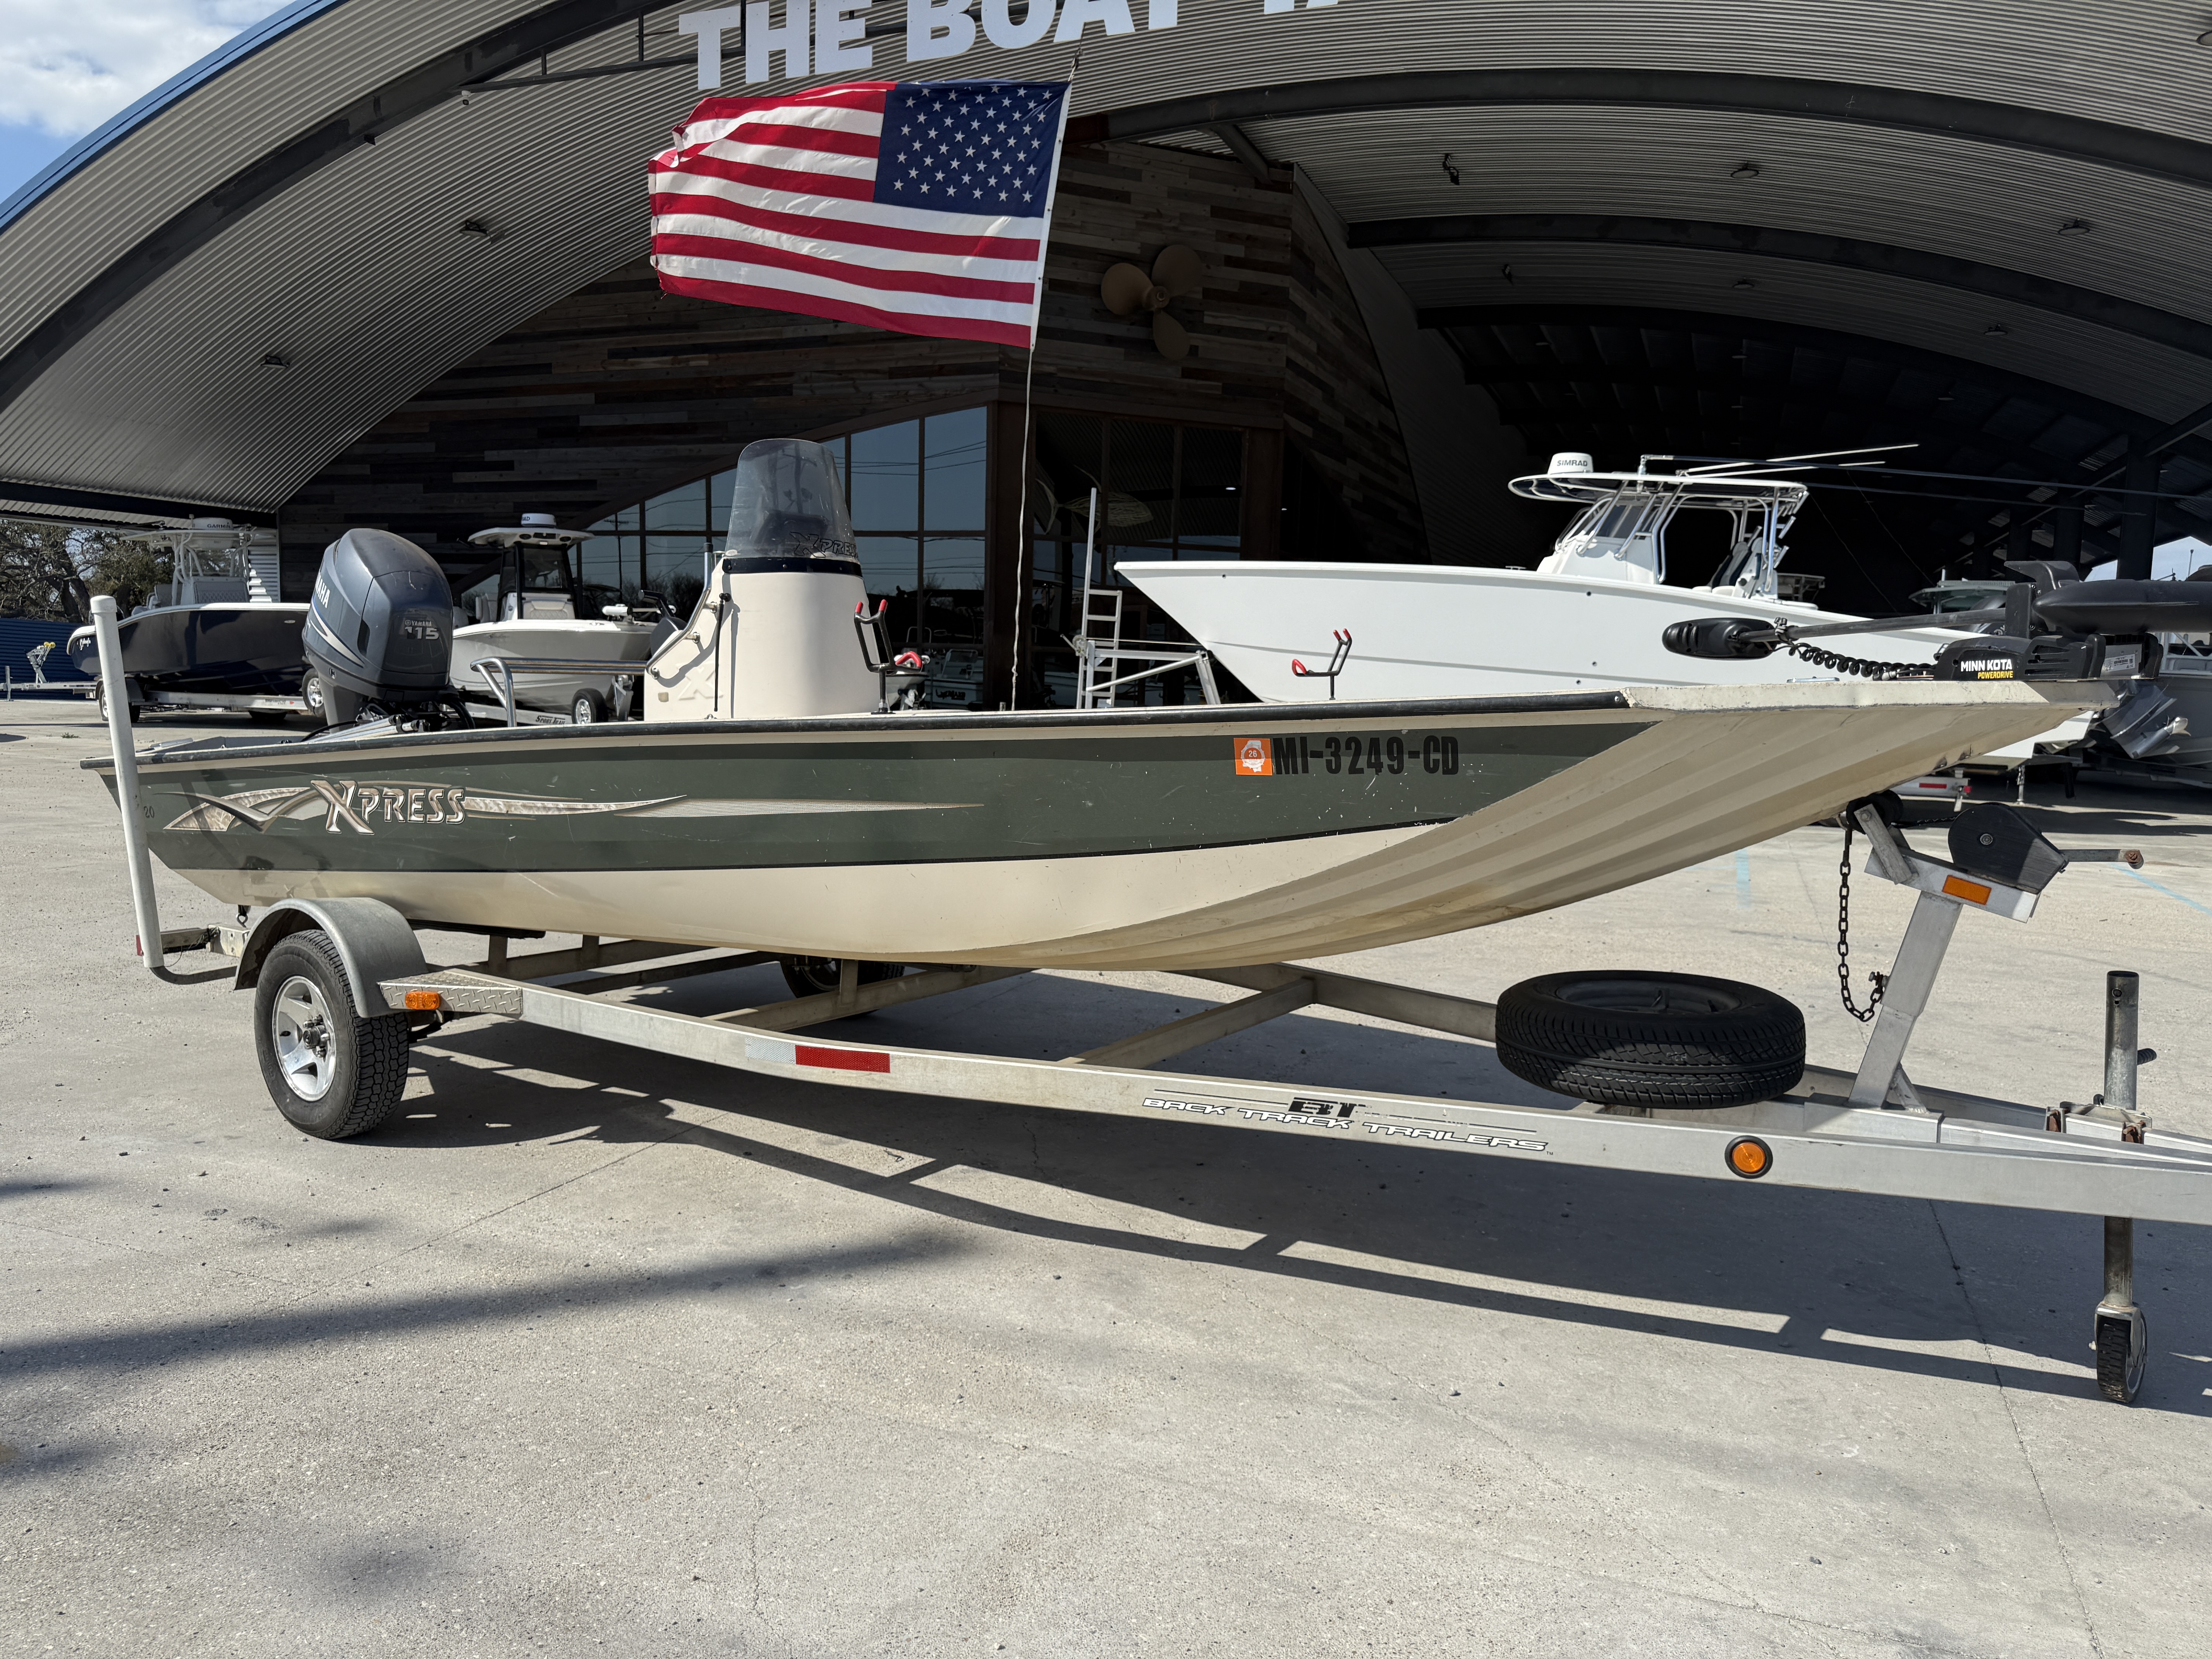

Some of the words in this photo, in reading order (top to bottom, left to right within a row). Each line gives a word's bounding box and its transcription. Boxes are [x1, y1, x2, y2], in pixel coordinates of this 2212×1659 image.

[678, 0, 872, 90] THE
[405, 626, 439, 640] 115
[1961, 660, 1985, 672] MINN
[1987, 659, 2013, 671] KOTA
[1978, 671, 2013, 679] POWERDRIVE
[1273, 736, 1459, 775] MI-3249-CD
[310, 780, 465, 835] XPRESS
[1142, 1097, 1236, 1115] BACK
[1238, 1108, 1355, 1129] TRACK
[1362, 1121, 1549, 1151] TRAILERS
